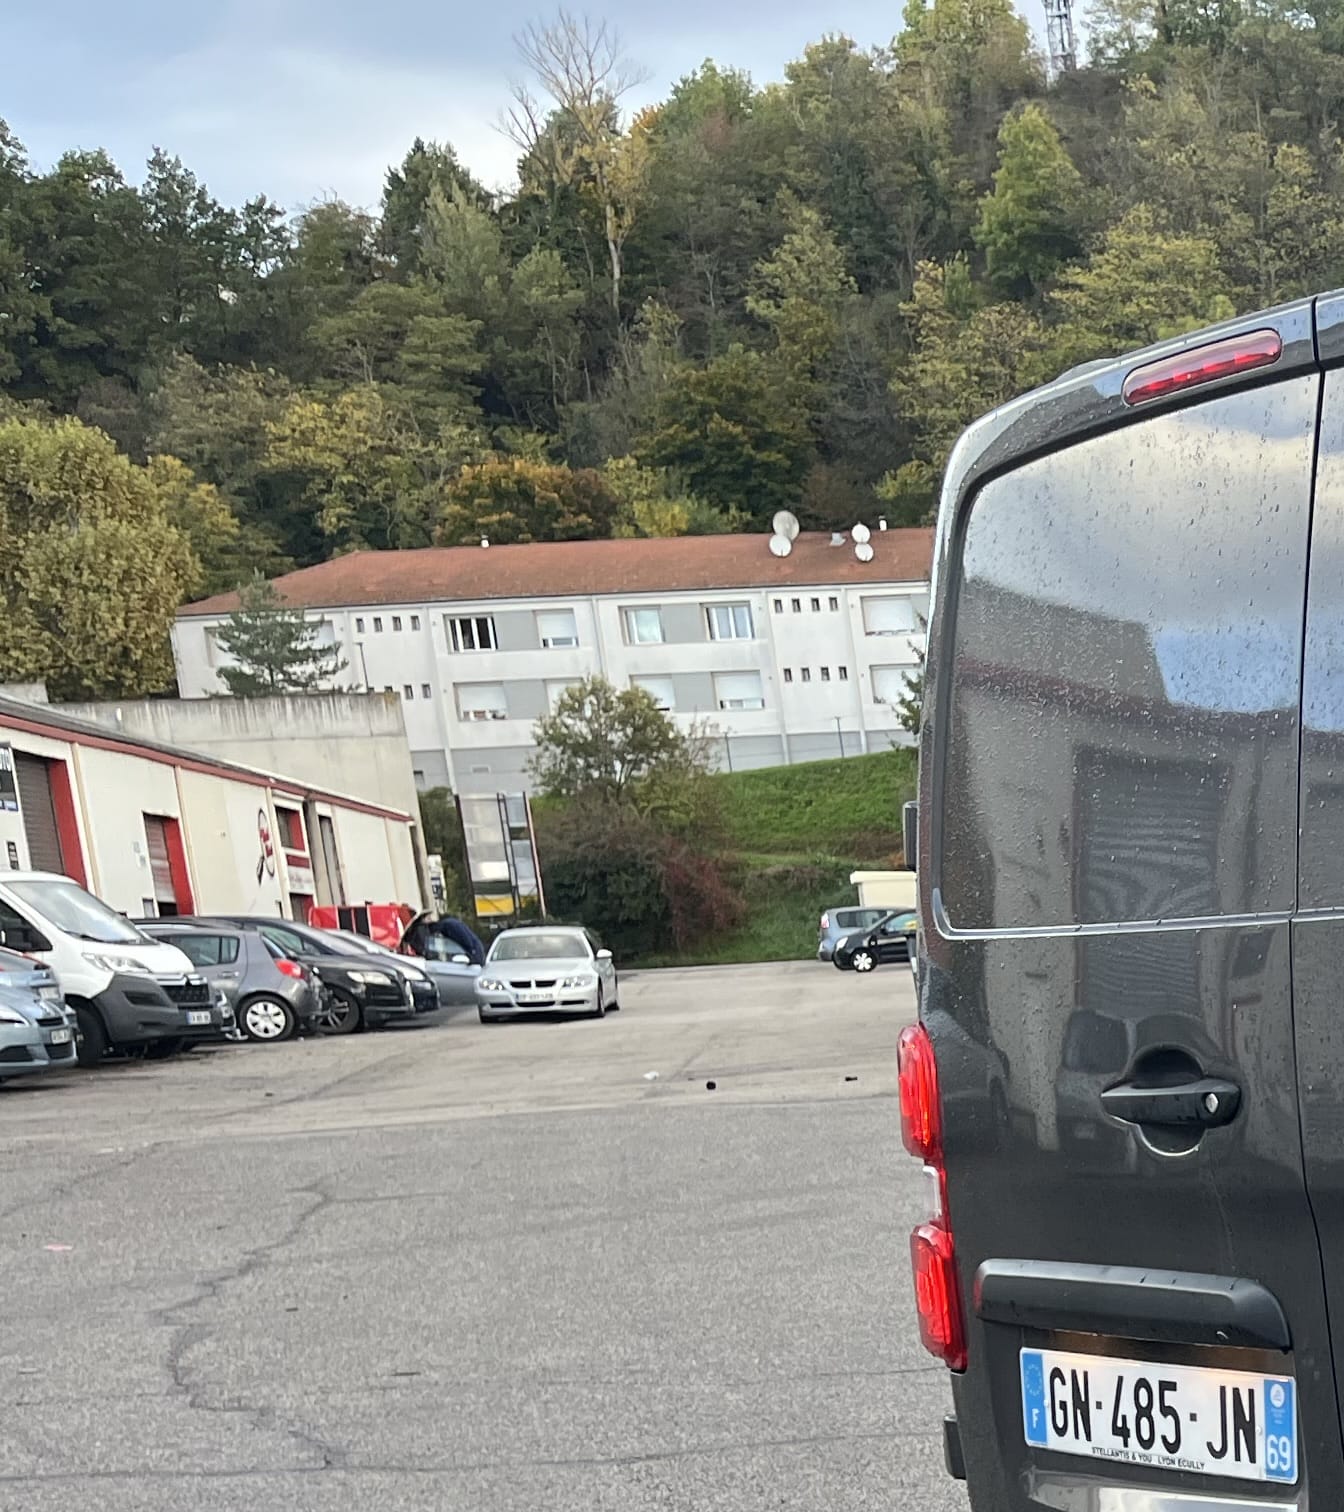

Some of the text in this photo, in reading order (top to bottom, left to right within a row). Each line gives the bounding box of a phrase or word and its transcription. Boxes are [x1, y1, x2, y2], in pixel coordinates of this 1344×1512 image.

[1031, 1407, 1041, 1430] F
[1049, 1366, 1257, 1464] GN-485-JN
[1158, 1455, 1176, 1466] LYON
[1267, 1434, 1291, 1472] 69
